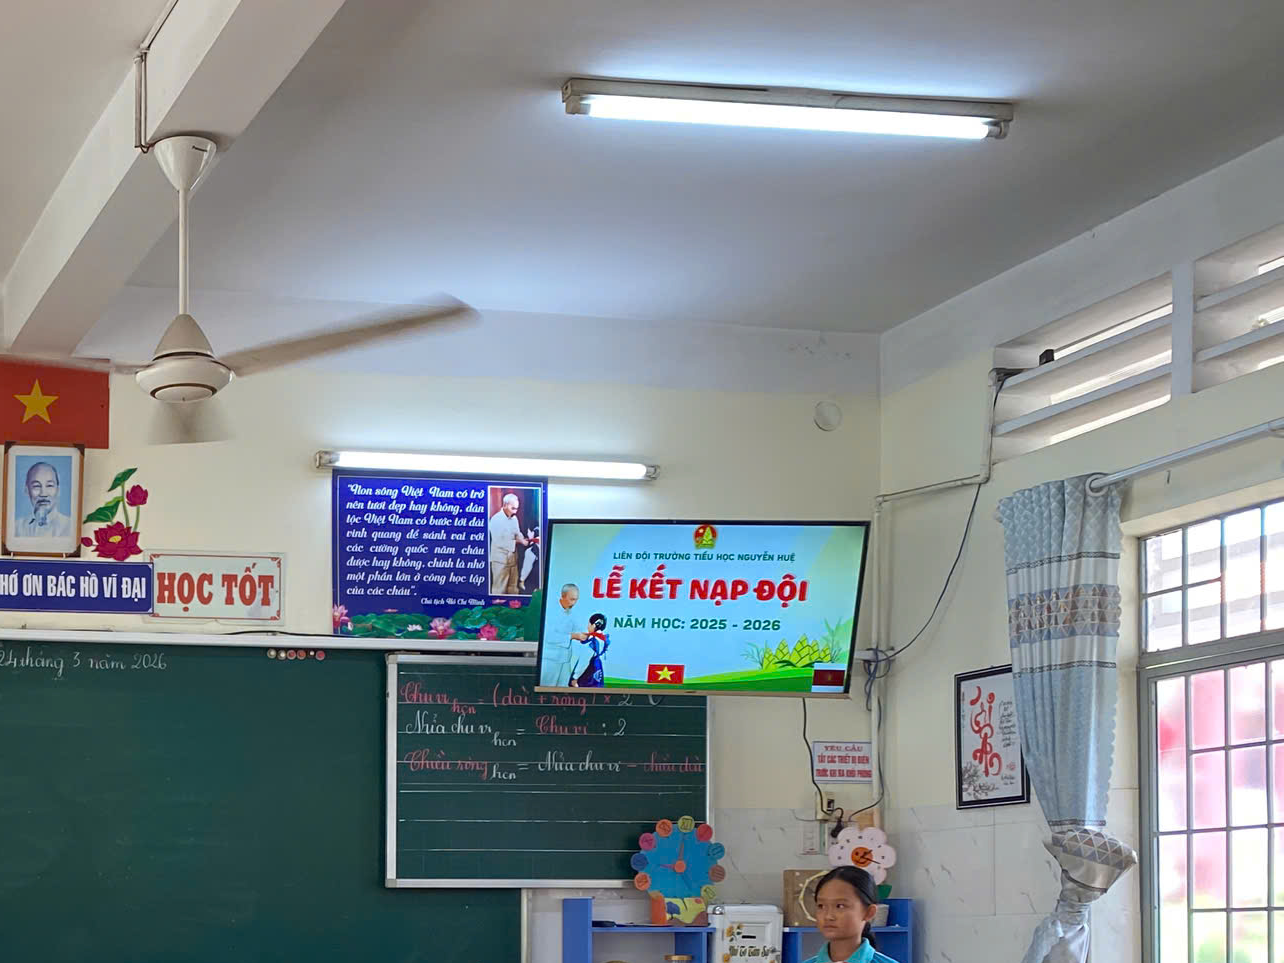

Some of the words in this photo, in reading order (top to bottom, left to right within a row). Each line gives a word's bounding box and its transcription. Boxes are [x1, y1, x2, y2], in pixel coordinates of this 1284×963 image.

[613, 551, 633, 560] LIÊN
[635, 551, 651, 562] ĐỘI
[653, 551, 691, 560] TRƯỜNG
[694, 551, 714, 561] TIỂU
[716, 553, 735, 562] HỌC
[737, 551, 774, 561] NGUYỄN
[777, 553, 796, 563] HUỆ
[22, 573, 43, 596] ƠN
[47, 571, 76, 598] BÁC
[80, 570, 98, 598] HỒ
[103, 573, 118, 598] VĨ
[121, 576, 146, 602] ĐẠI
[156, 572, 213, 612] HỌC
[221, 562, 274, 606] TỐT
[592, 564, 625, 599] LỄ
[629, 564, 683, 600] KẾT
[689, 579, 749, 606] NẠP
[752, 573, 808, 608] ĐỘI
[613, 614, 646, 628] NĂM
[651, 618, 685, 632] HỌC:
[690, 618, 727, 630] 2025
[743, 619, 781, 631] 2026
[19, 646, 65, 677] tháng
[73, 651, 81, 667] 3
[89, 653, 125, 670] năm
[131, 652, 167, 670] 2026
[614, 718, 627, 736] 2
